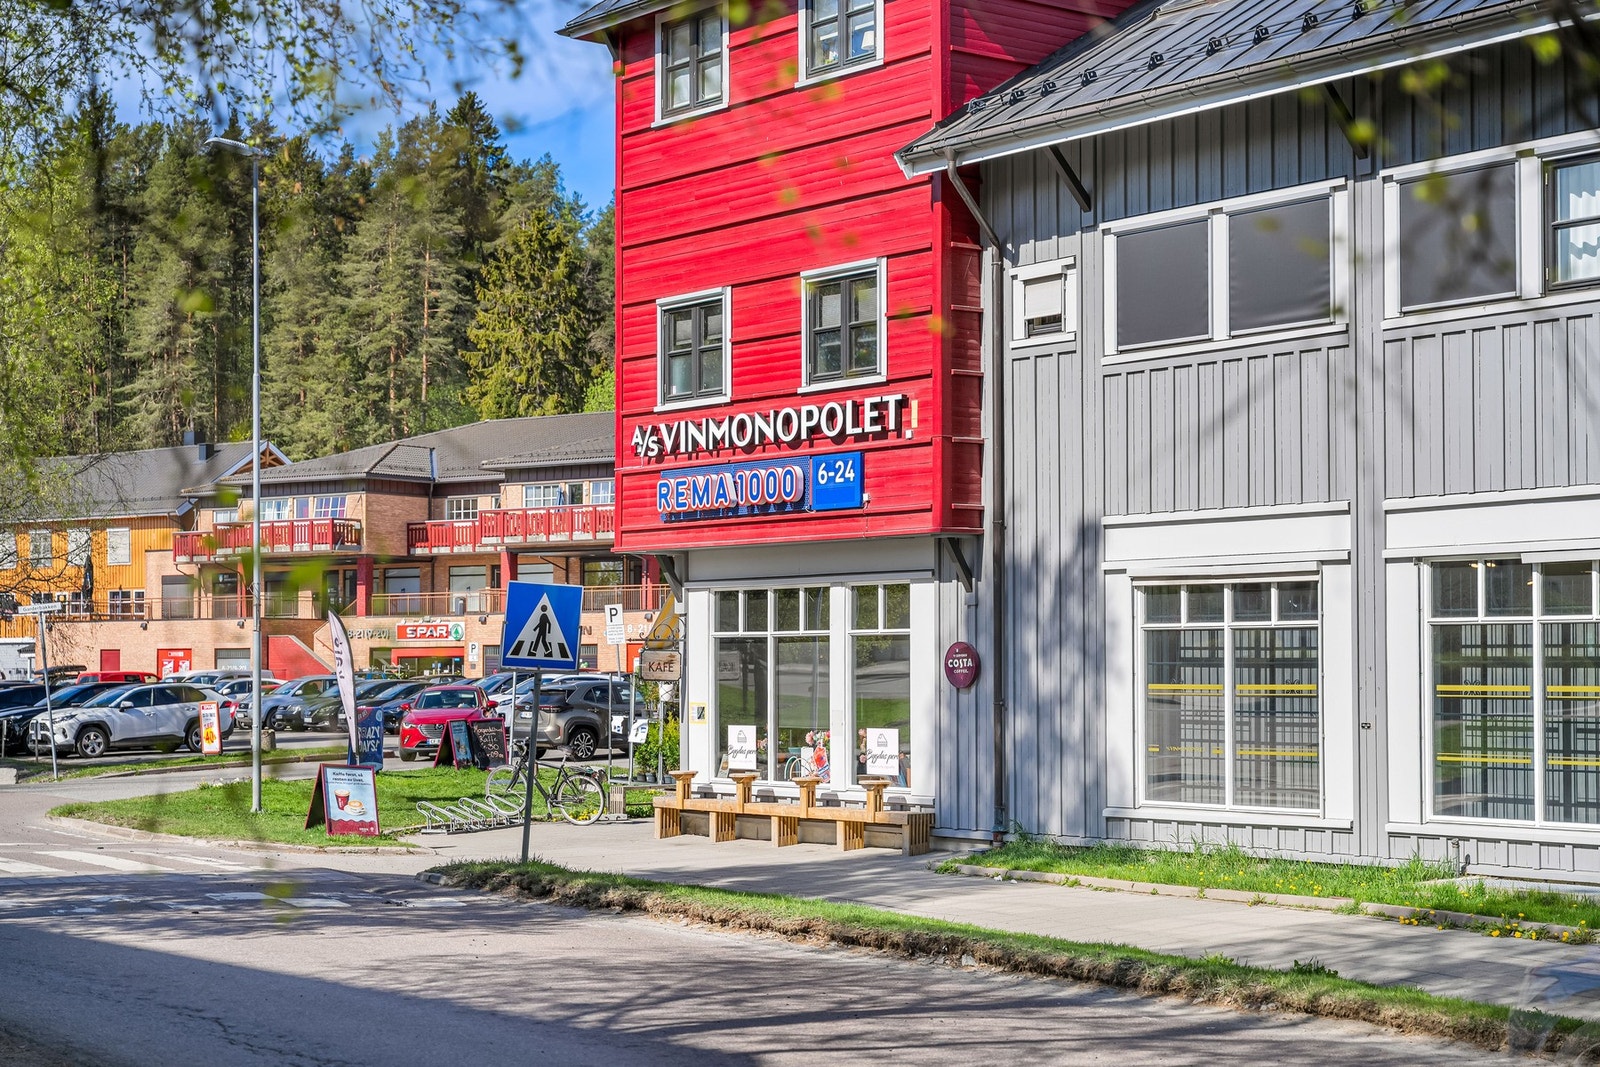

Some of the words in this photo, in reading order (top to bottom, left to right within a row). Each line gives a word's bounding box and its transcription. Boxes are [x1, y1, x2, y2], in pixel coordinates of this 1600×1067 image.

[818, 460, 855, 484] 6-24
[657, 472, 731, 513] REMA
[736, 465, 800, 505] 1000
[609, 607, 618, 623] P
[406, 626, 447, 638] SPAR
[948, 658, 973, 668] COSTA
